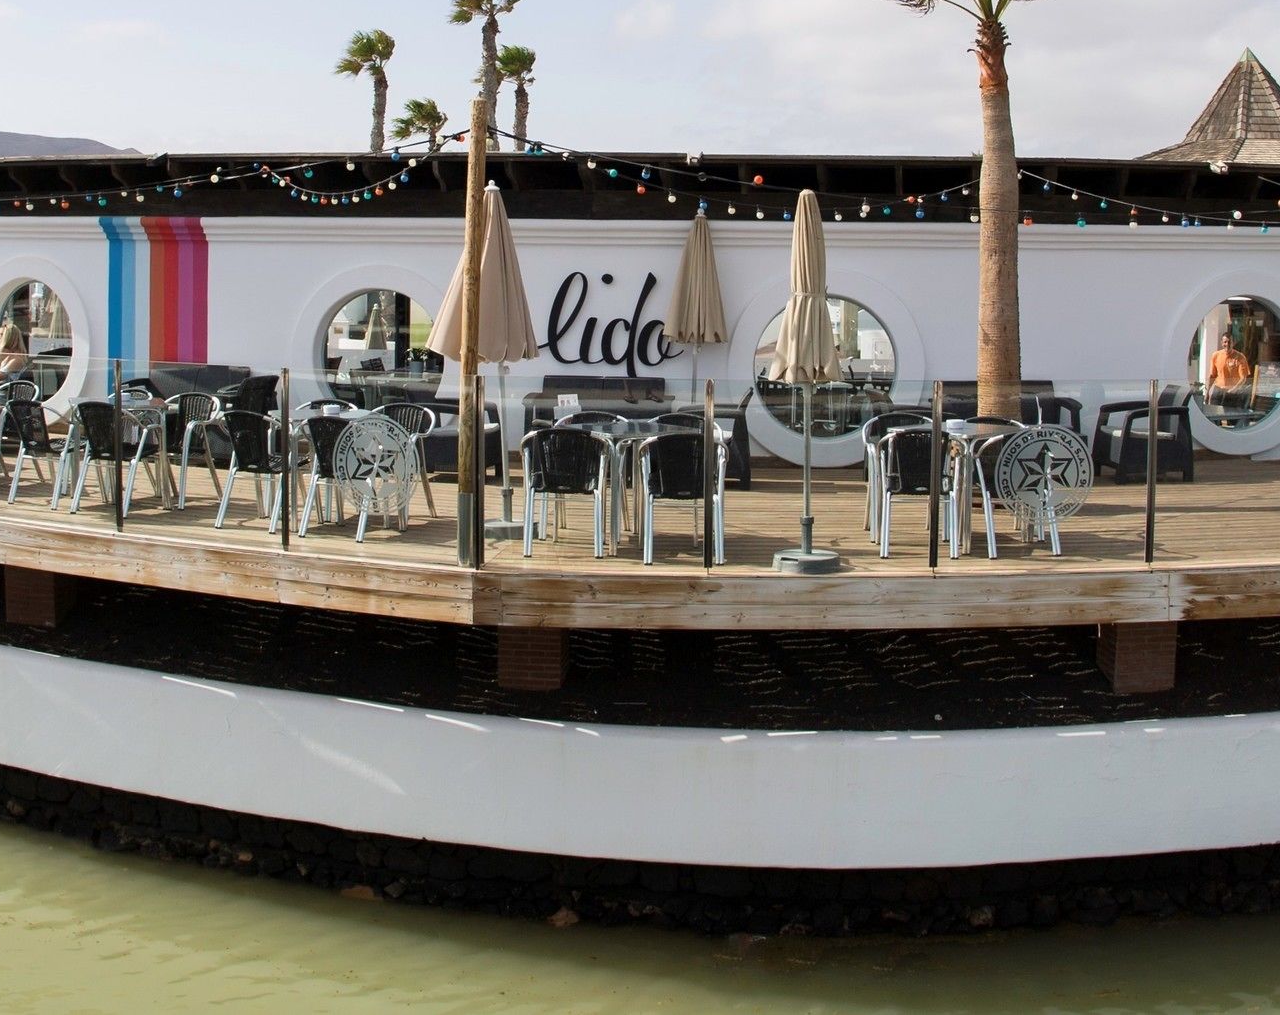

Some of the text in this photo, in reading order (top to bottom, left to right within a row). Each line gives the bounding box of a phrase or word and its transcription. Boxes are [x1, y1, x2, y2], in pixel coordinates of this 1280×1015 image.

[538, 271, 684, 378] lido
[1003, 442, 1022, 467] HIJOS
[1021, 433, 1035, 444] DE
[1074, 448, 1086, 467] S.A.
